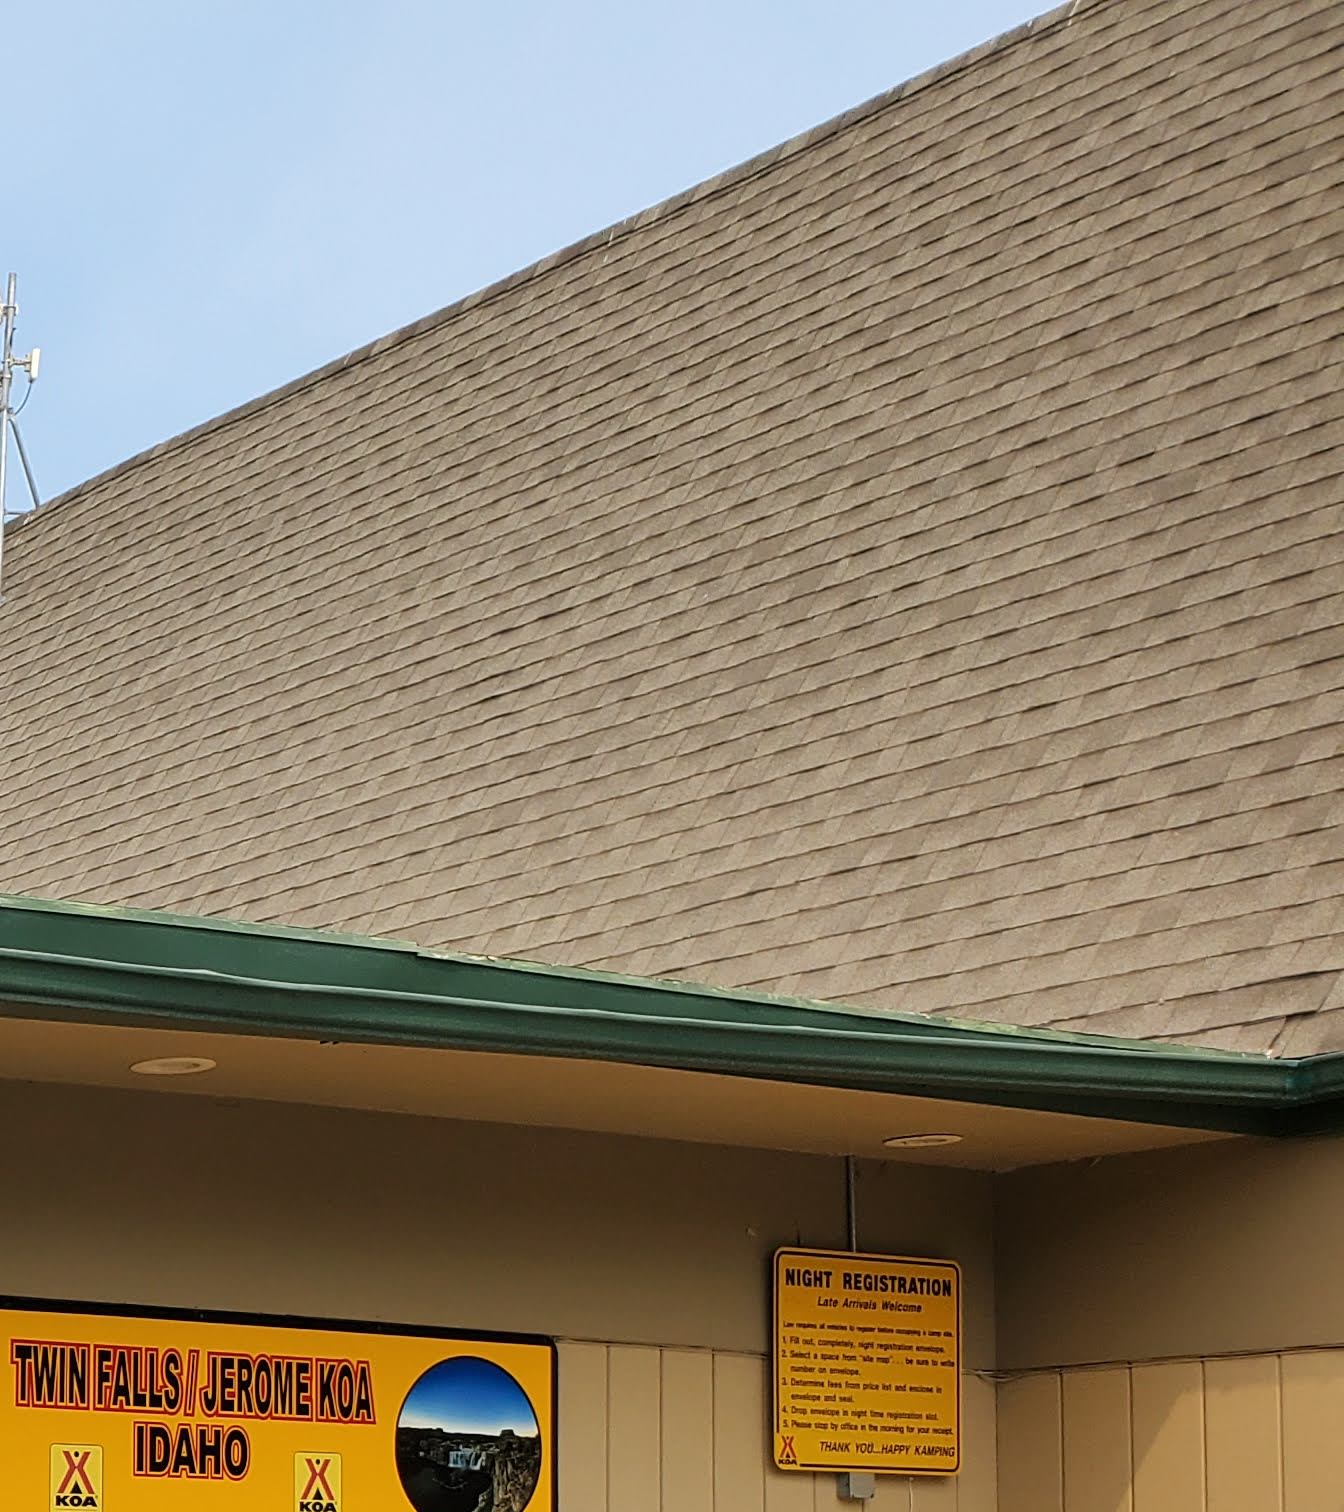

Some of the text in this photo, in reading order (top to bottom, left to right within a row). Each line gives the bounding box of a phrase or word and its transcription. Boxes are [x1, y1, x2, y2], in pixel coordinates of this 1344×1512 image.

[785, 1268, 951, 1296] NIGHT REGISTRATION
[817, 1295, 922, 1312] Late Arrivals Welcome
[13, 1341, 90, 1409] TWIN
[94, 1346, 181, 1414] FALLS
[201, 1352, 313, 1421] JEROME
[316, 1358, 375, 1424] KOA
[135, 1421, 250, 1480] IDAHO
[819, 1441, 850, 1452] THANK
[914, 1445, 955, 1457] KAMPING
[55, 1494, 98, 1508] KOA
[299, 1501, 337, 1512] KOA
